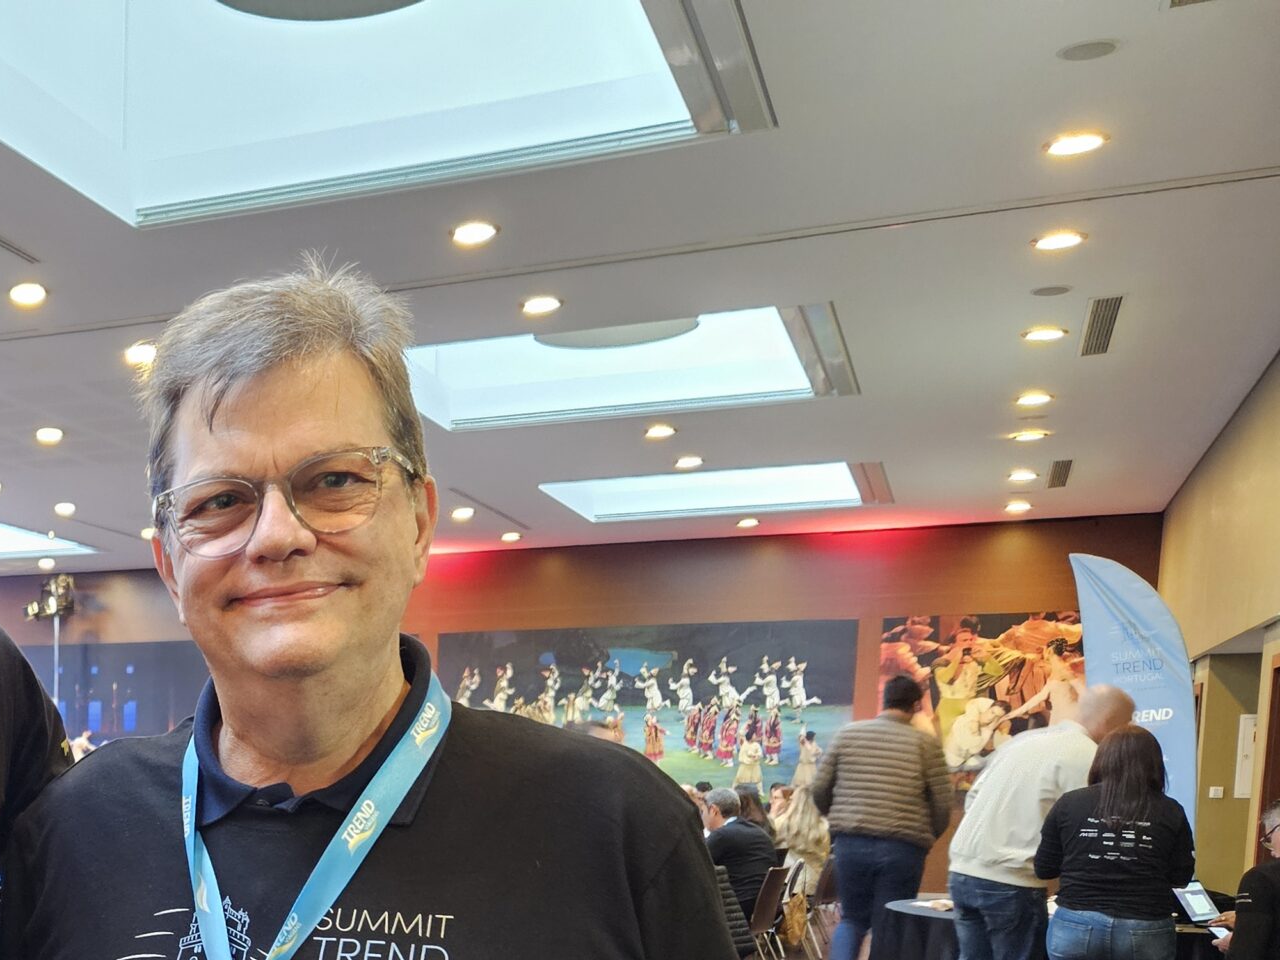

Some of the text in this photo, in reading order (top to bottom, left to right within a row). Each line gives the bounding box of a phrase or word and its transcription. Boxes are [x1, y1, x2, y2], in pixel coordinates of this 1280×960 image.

[1113, 659, 1164, 674] TREND
[410, 702, 436, 740] TREND
[1131, 708, 1174, 723] REND
[341, 799, 376, 847] TREND
[314, 907, 455, 939] SUMMIT
